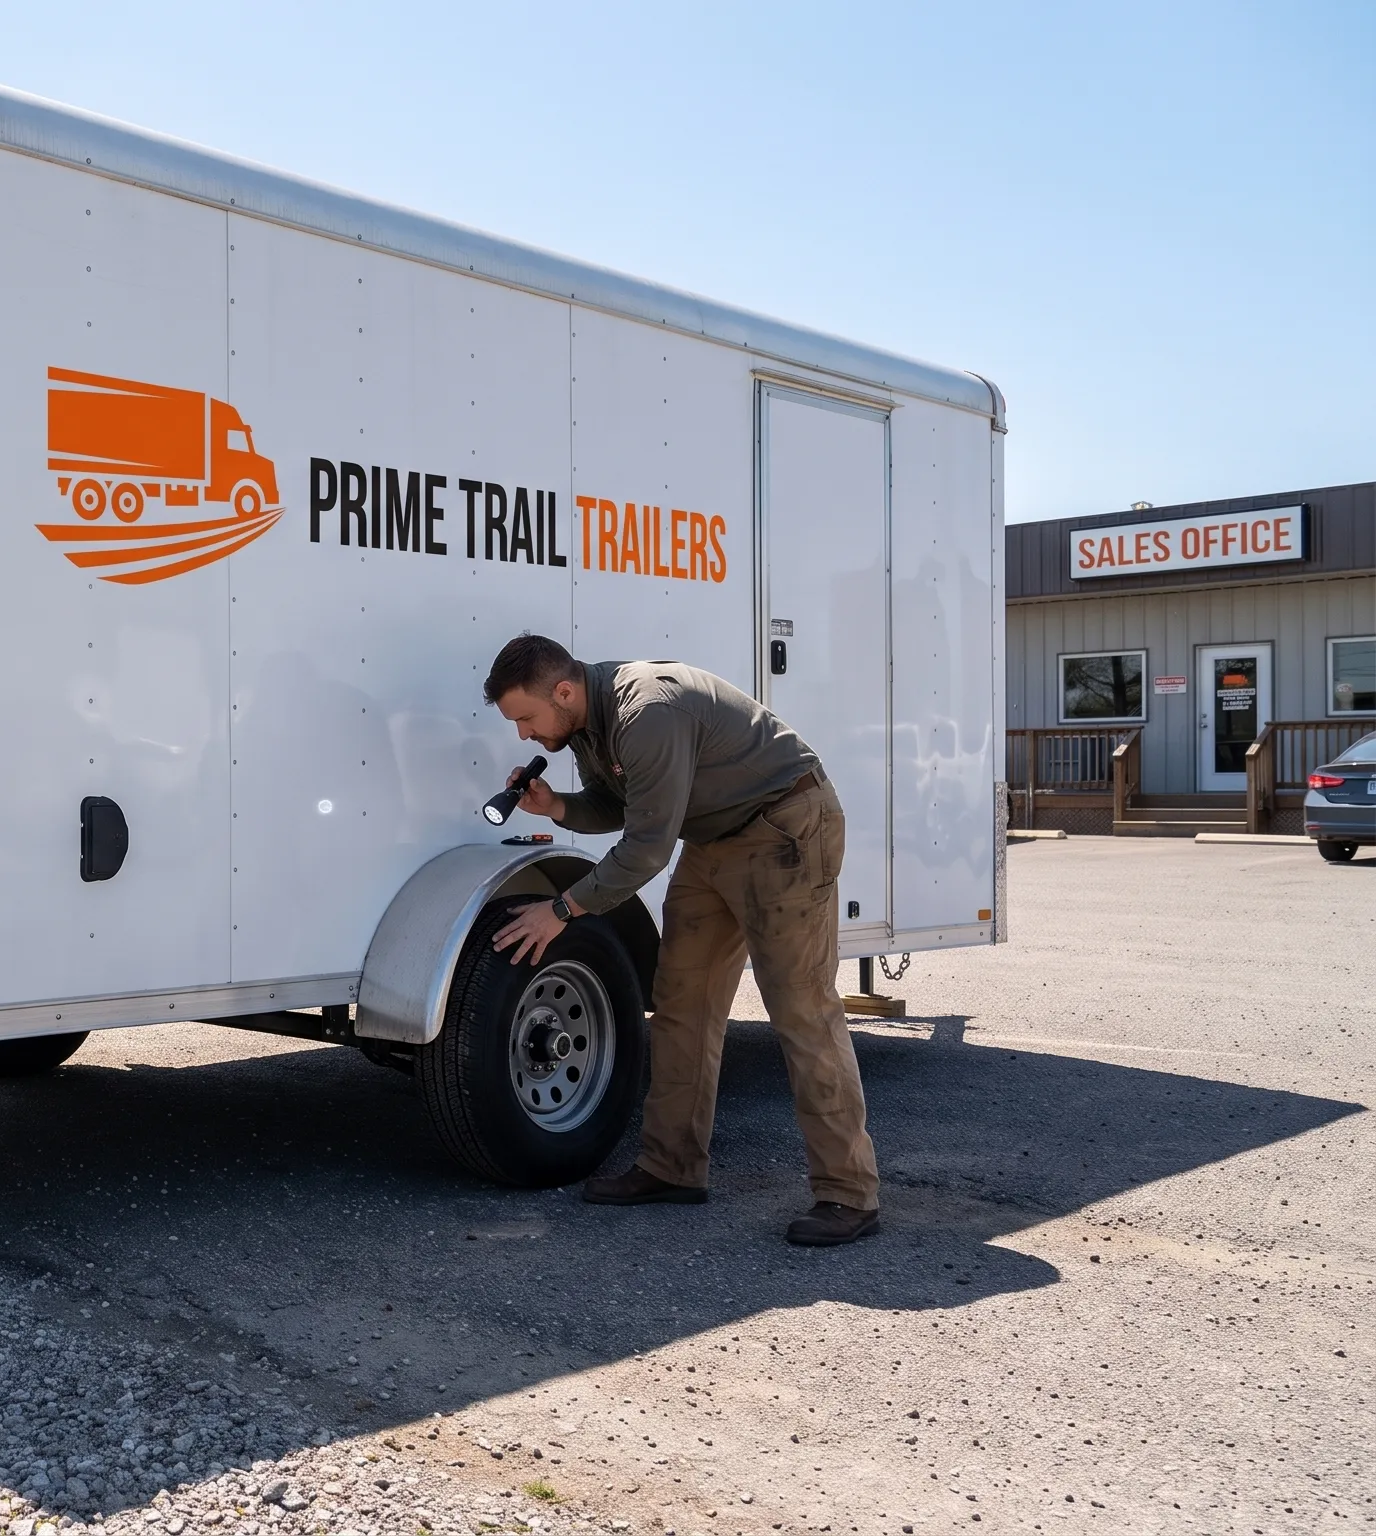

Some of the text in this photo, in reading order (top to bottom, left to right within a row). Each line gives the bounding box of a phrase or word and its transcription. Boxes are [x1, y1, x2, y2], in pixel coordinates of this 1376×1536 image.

[309, 456, 727, 584] PRIME TRAIL TRAILERS
[1078, 517, 1292, 570] SALES OFFICE
